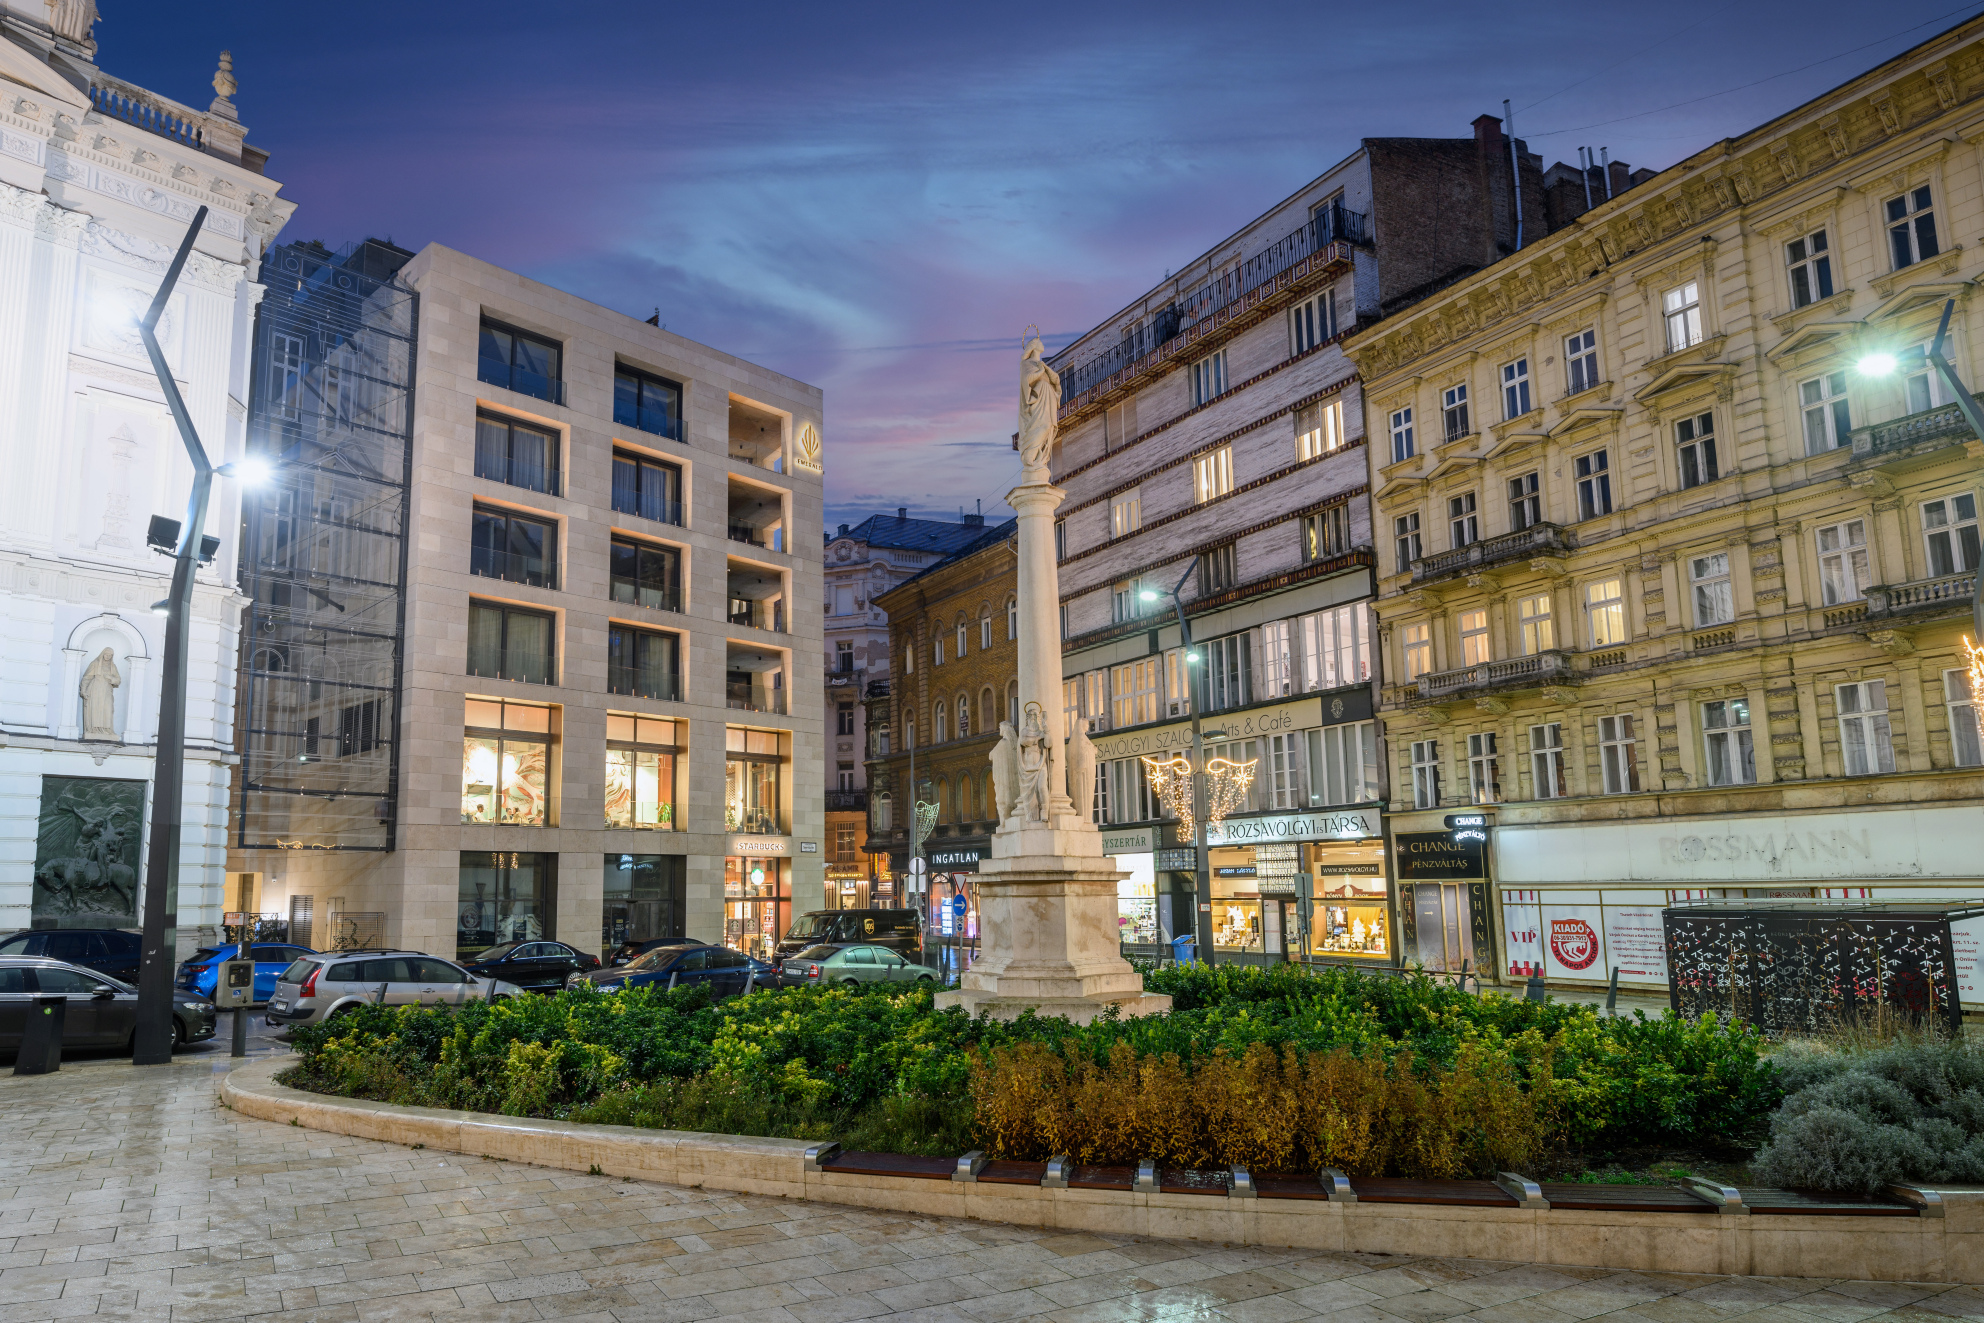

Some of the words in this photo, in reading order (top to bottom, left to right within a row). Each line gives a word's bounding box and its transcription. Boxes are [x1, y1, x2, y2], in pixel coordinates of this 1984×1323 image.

[1244, 717, 1255, 735] &
[1258, 710, 1292, 732] Café
[1227, 819, 1316, 839] RÓZSAVÖLGYI
[1323, 813, 1370, 835] TÁRSA
[1455, 817, 1483, 826] CHANGE
[1455, 829, 1486, 842] PÉNZVÁLTÓ
[737, 842, 785, 851] STARBUCKS
[1410, 841, 1466, 853] CHANGE
[1659, 829, 1871, 865] ROSSMANN
[932, 852, 979, 864] INGATLAN
[831, 864, 859, 872] AL-AMIR
[1473, 885, 1486, 972] CHANGE
[1553, 921, 1585, 934] KIADÓ
[1510, 930, 1537, 944] VIP
[1559, 956, 1584, 970] NAPOS
[1584, 940, 1598, 967] AKCIÓK
